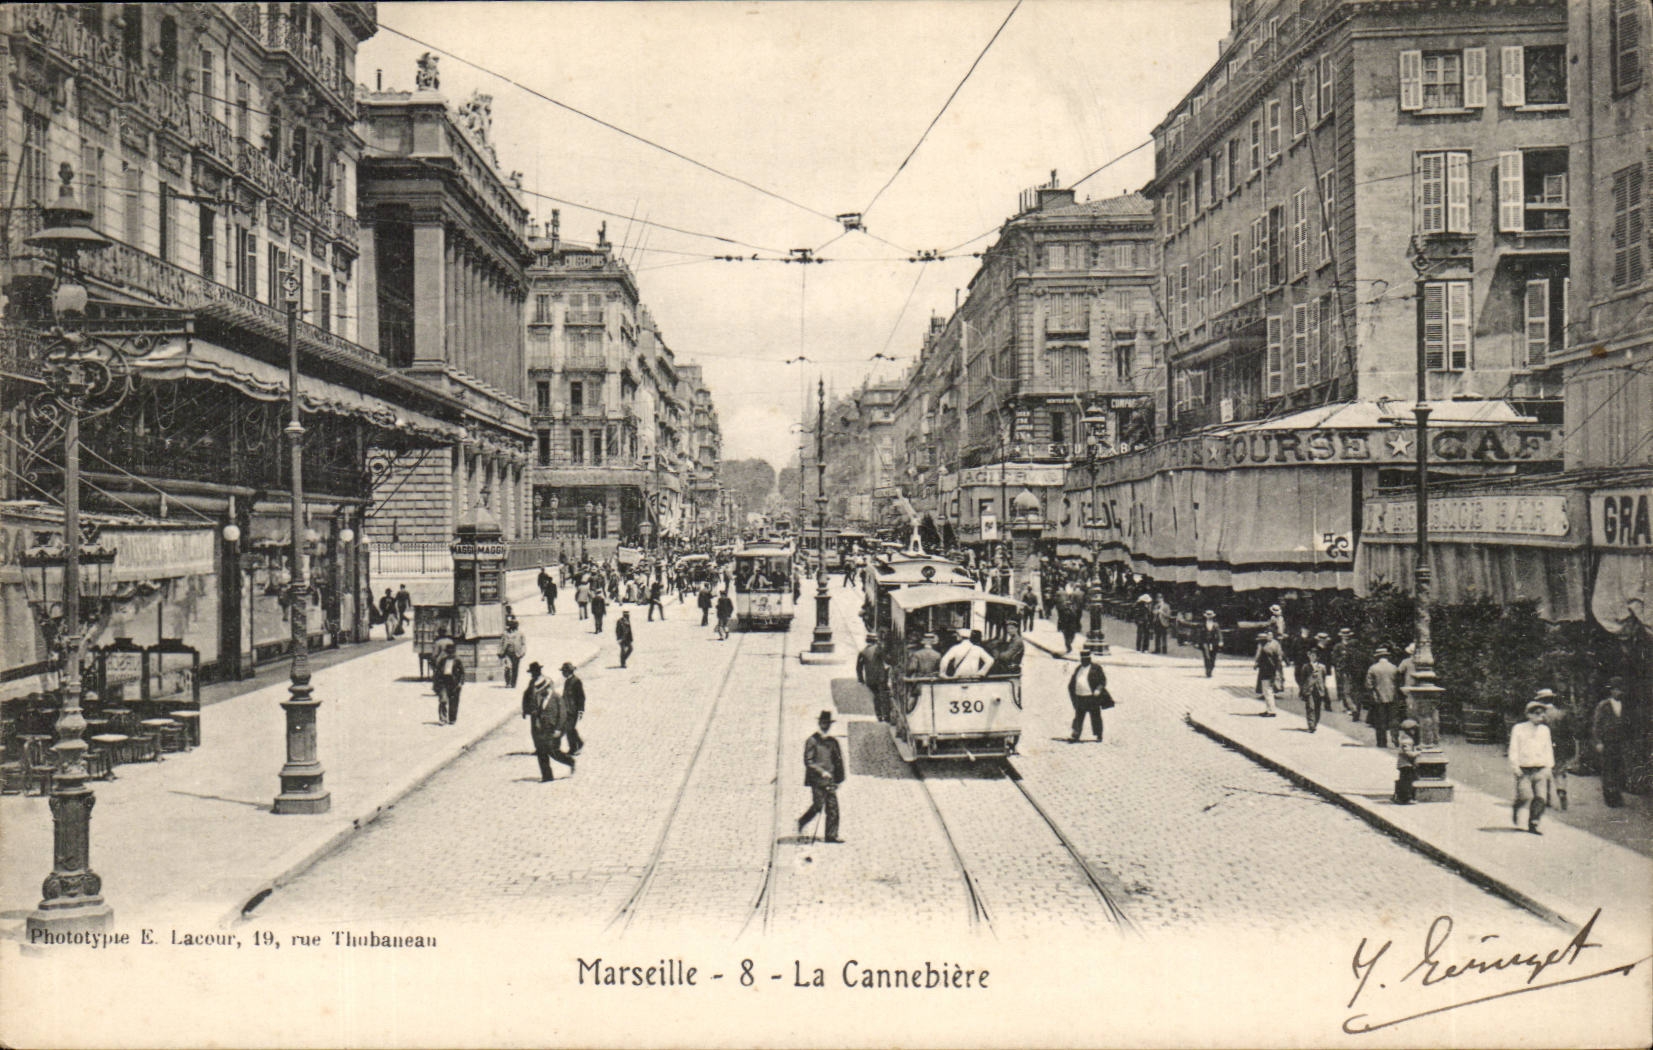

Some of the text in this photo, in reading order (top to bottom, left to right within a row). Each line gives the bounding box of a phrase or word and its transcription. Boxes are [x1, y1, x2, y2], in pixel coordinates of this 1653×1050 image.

[1431, 430, 1565, 461] CAF
[1496, 498, 1547, 532] BAR
[1604, 495, 1652, 545] GRA
[450, 545, 475, 554] MAGGI
[477, 545, 504, 554] MAGGI
[949, 700, 984, 714] 320
